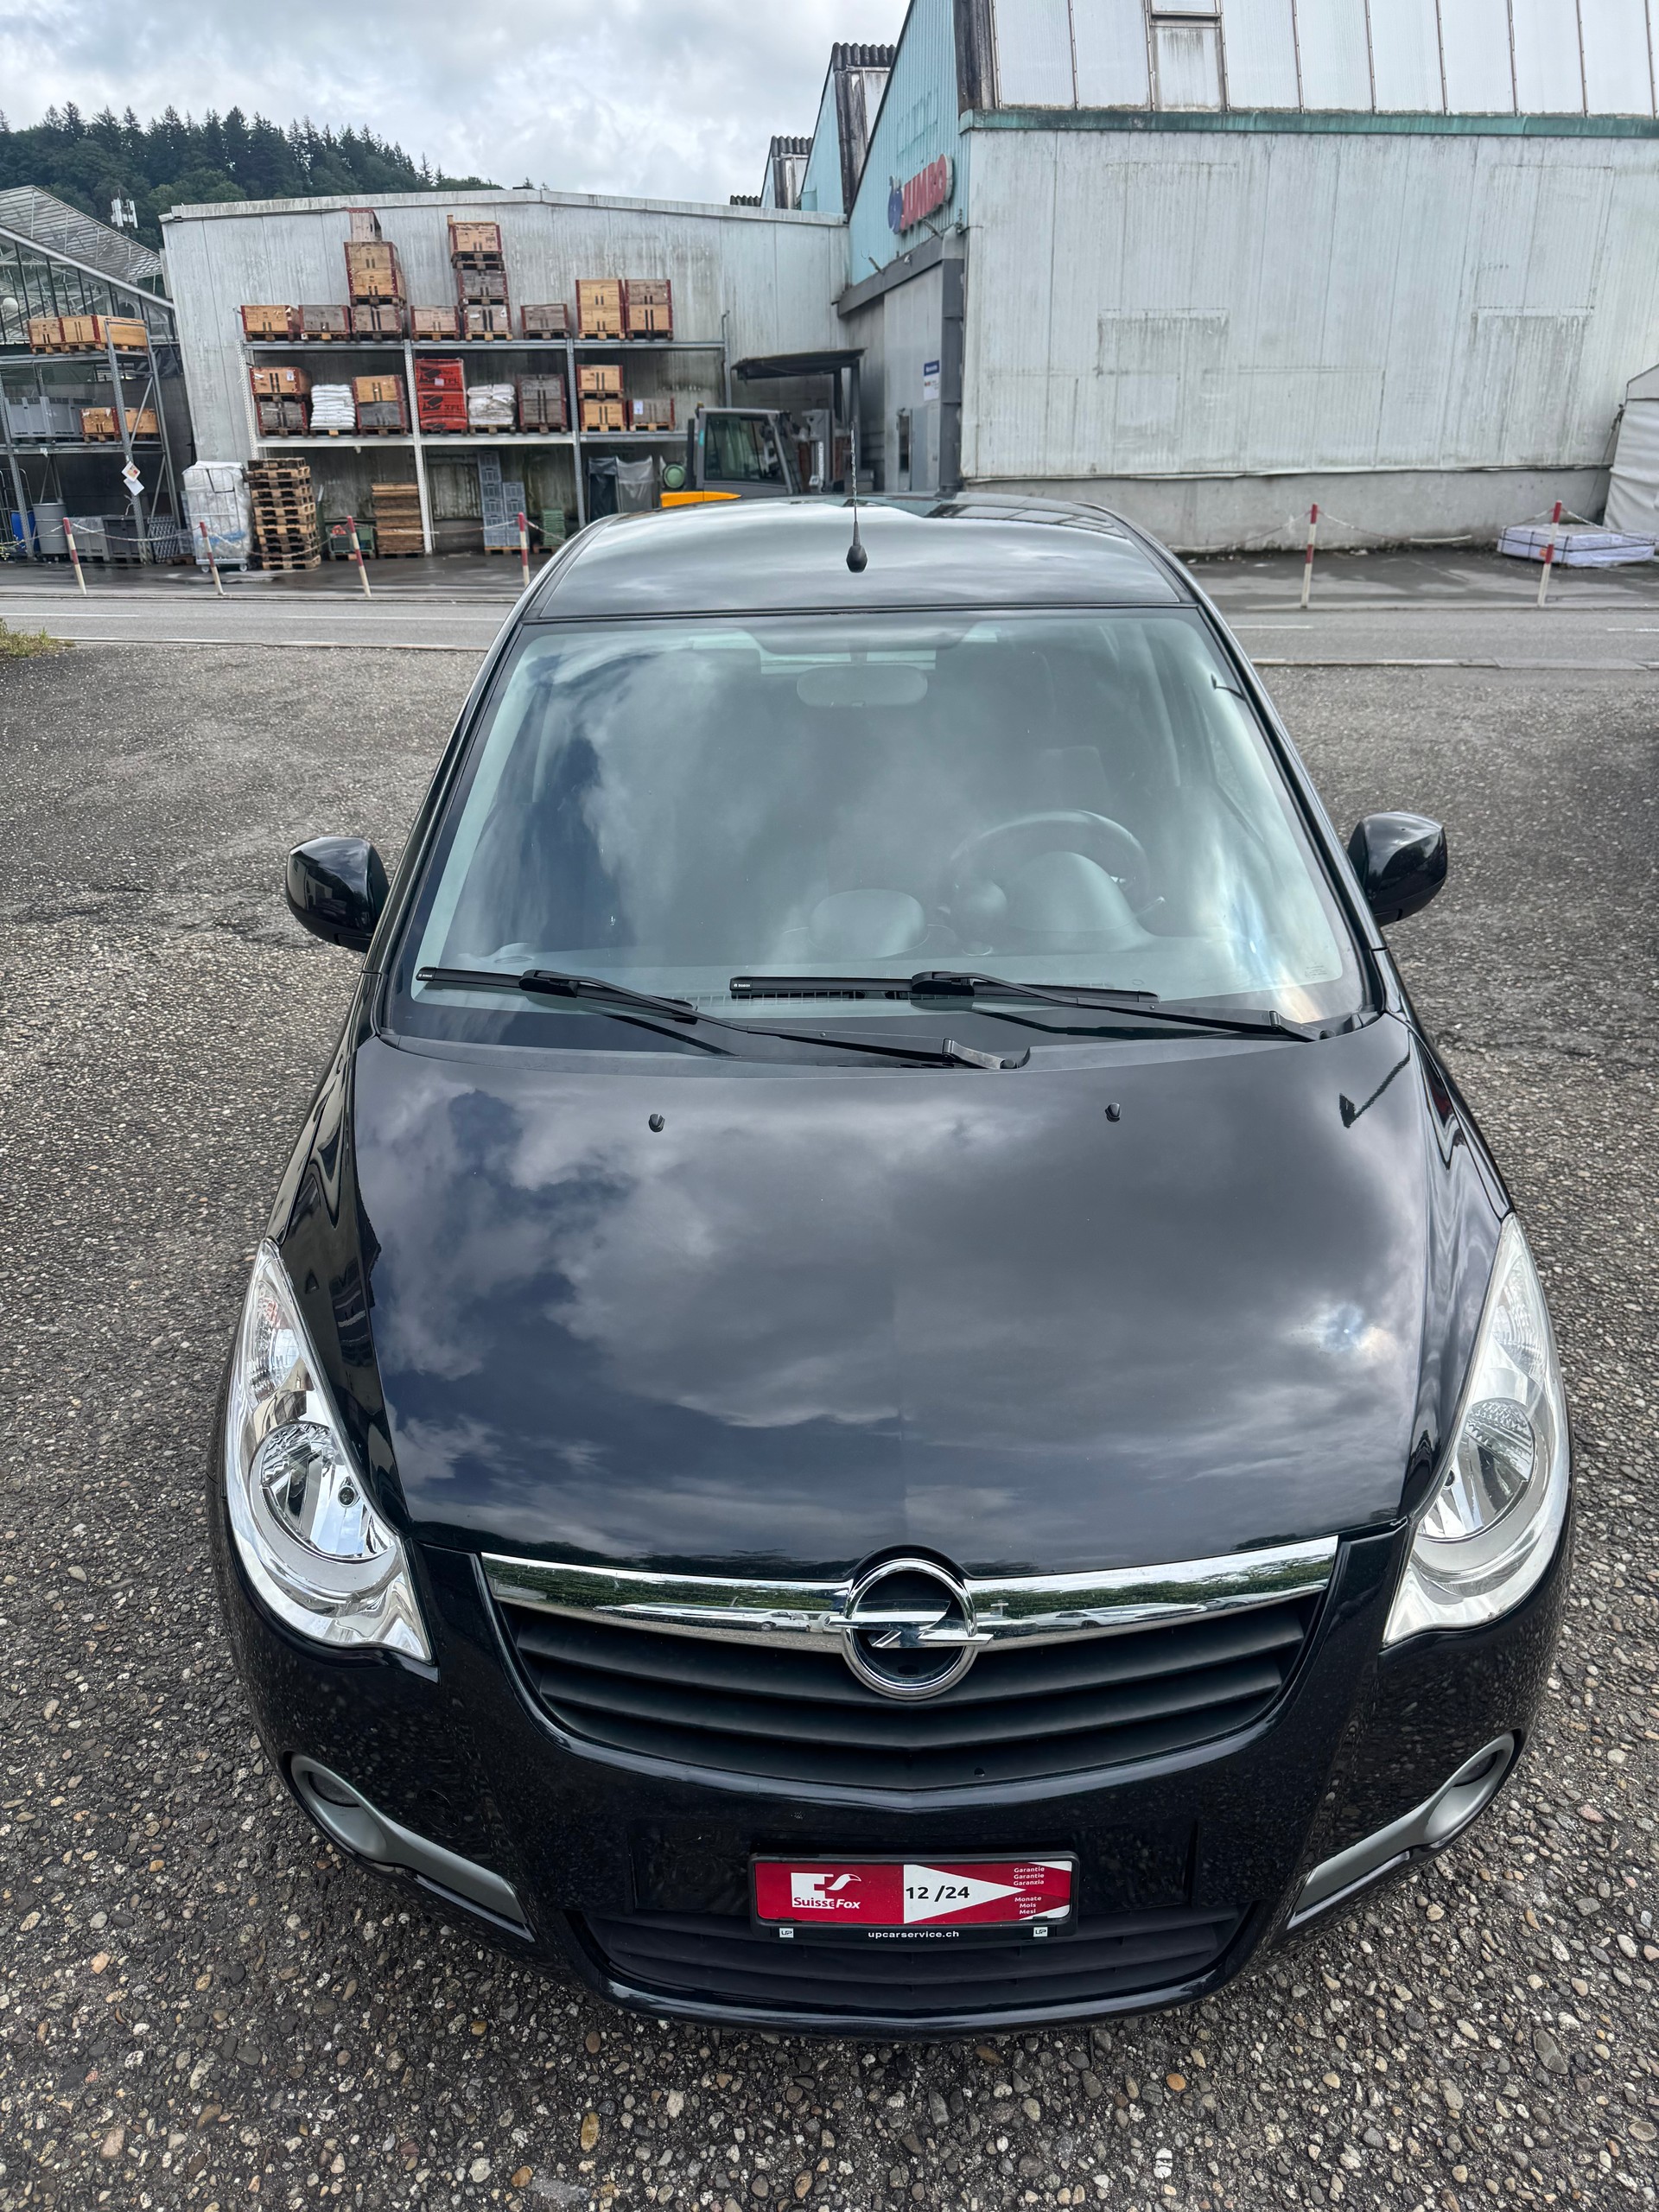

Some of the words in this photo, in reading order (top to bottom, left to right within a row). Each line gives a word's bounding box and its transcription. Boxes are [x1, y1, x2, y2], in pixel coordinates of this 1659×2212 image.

[899, 153, 948, 231] JUMBO
[906, 1886, 929, 1899] 12
[934, 1885, 969, 1902] /24
[868, 1930, 960, 1939] upcarservice.ch
